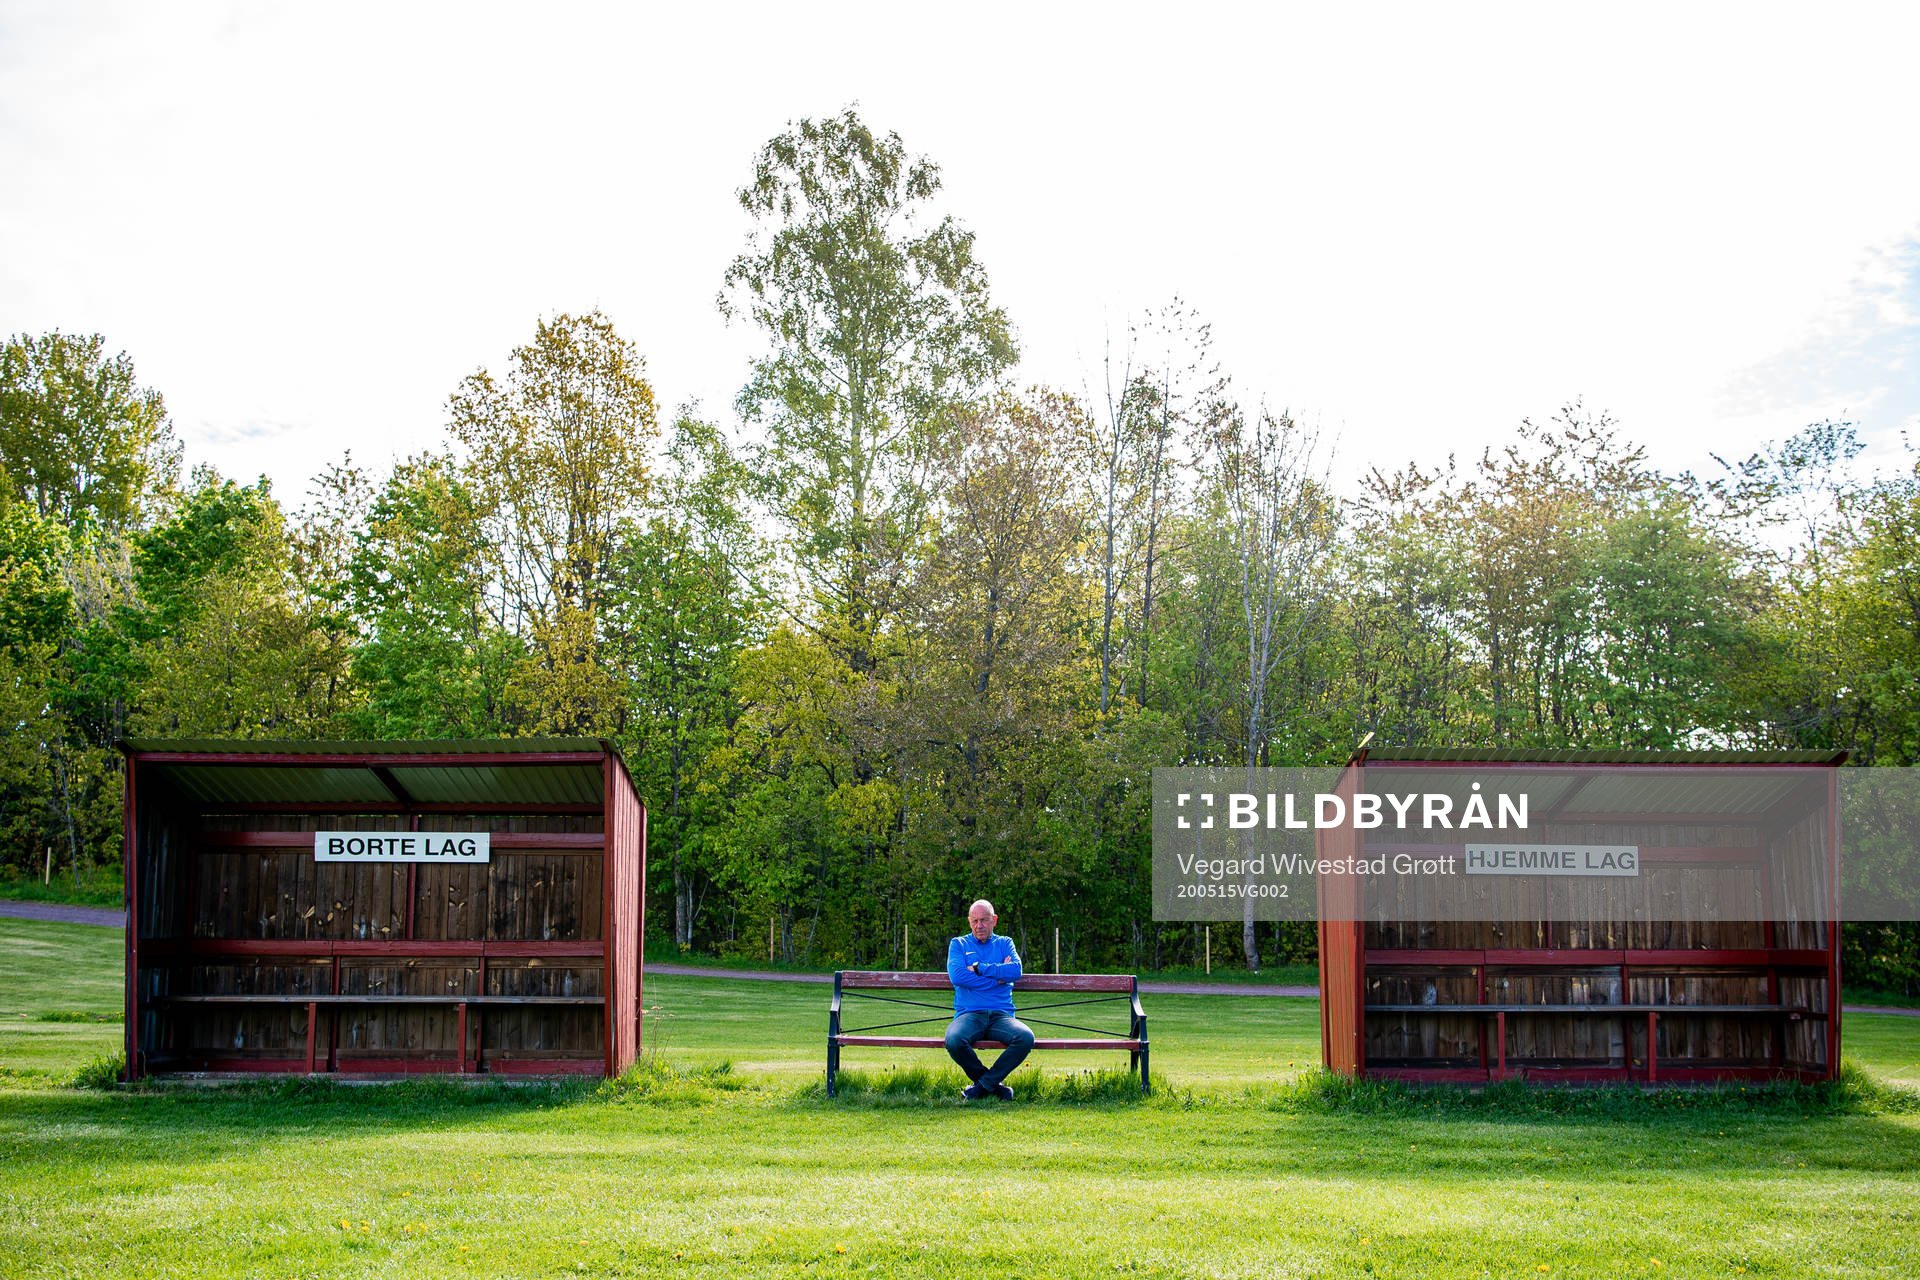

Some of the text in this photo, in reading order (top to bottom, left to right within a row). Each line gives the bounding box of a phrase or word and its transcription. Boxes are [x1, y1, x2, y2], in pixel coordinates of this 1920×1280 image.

[328, 837, 477, 857] BORTE LAG
[1468, 849, 1636, 871] HJEMME LAG
